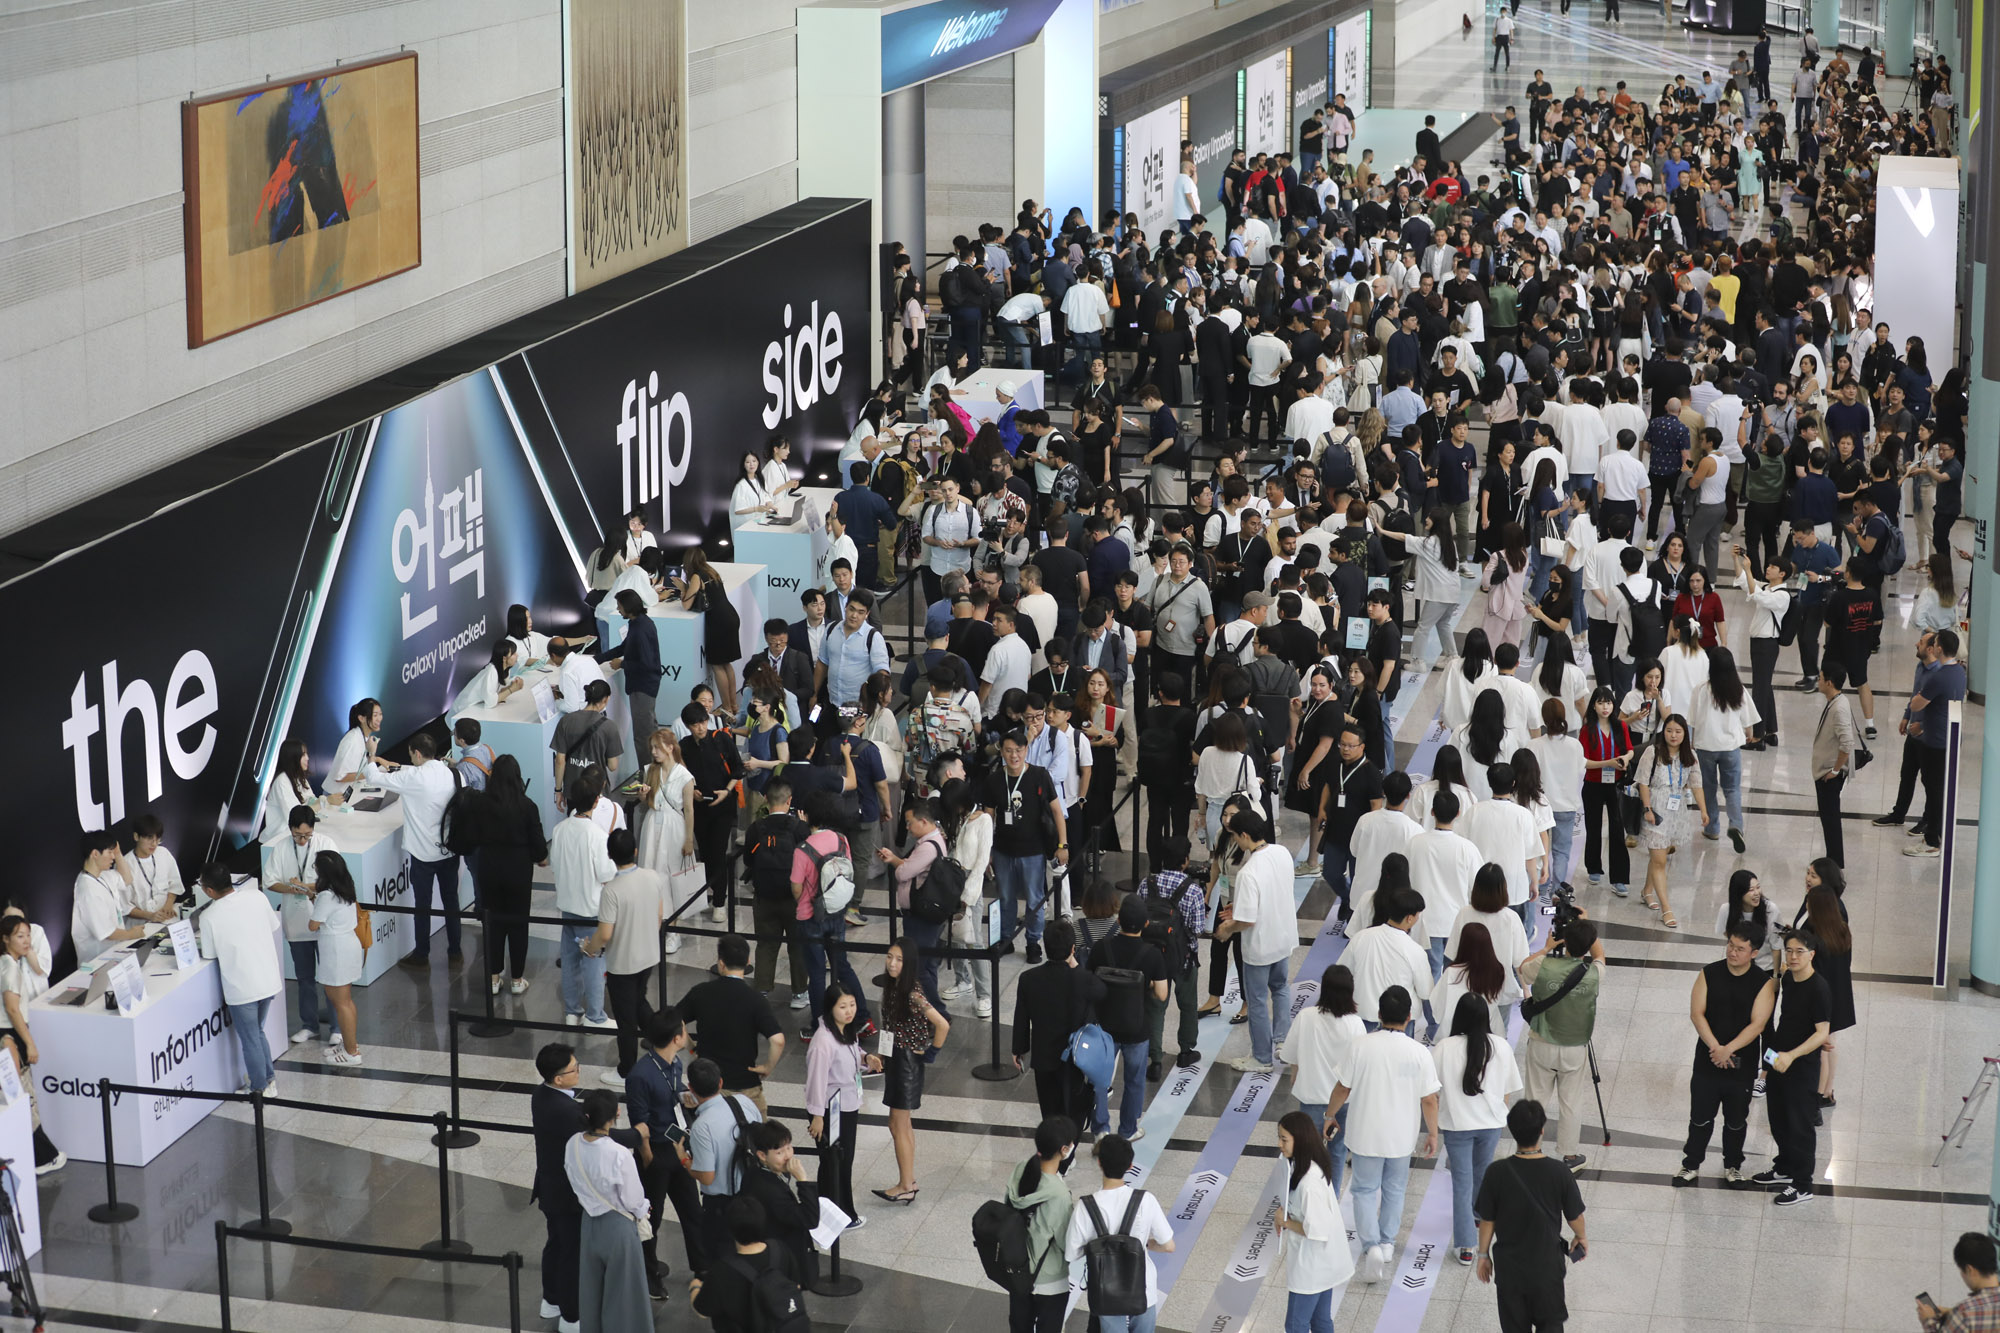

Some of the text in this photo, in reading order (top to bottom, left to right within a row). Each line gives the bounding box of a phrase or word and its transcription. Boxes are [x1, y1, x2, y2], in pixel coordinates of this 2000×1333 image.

[930, 7, 1009, 57] Welcome
[1193, 126, 1235, 165] Galaxy Unpacked
[1143, 145, 1164, 210] 언팩
[391, 430, 485, 641] 언팩
[62, 300, 843, 833] the flip side
[767, 574, 801, 592] laxy
[402, 615, 487, 684] Galaxy Unpacked
[375, 858, 410, 912] Medi
[376, 916, 396, 944] 미디어
[151, 1002, 233, 1084] Informat
[1171, 1077, 1192, 1096] Media
[1233, 1085, 1263, 1113] Samsung
[1176, 1188, 1209, 1221] Samsung
[1245, 1227, 1274, 1260] Members
[1412, 1243, 1436, 1271] Partner
